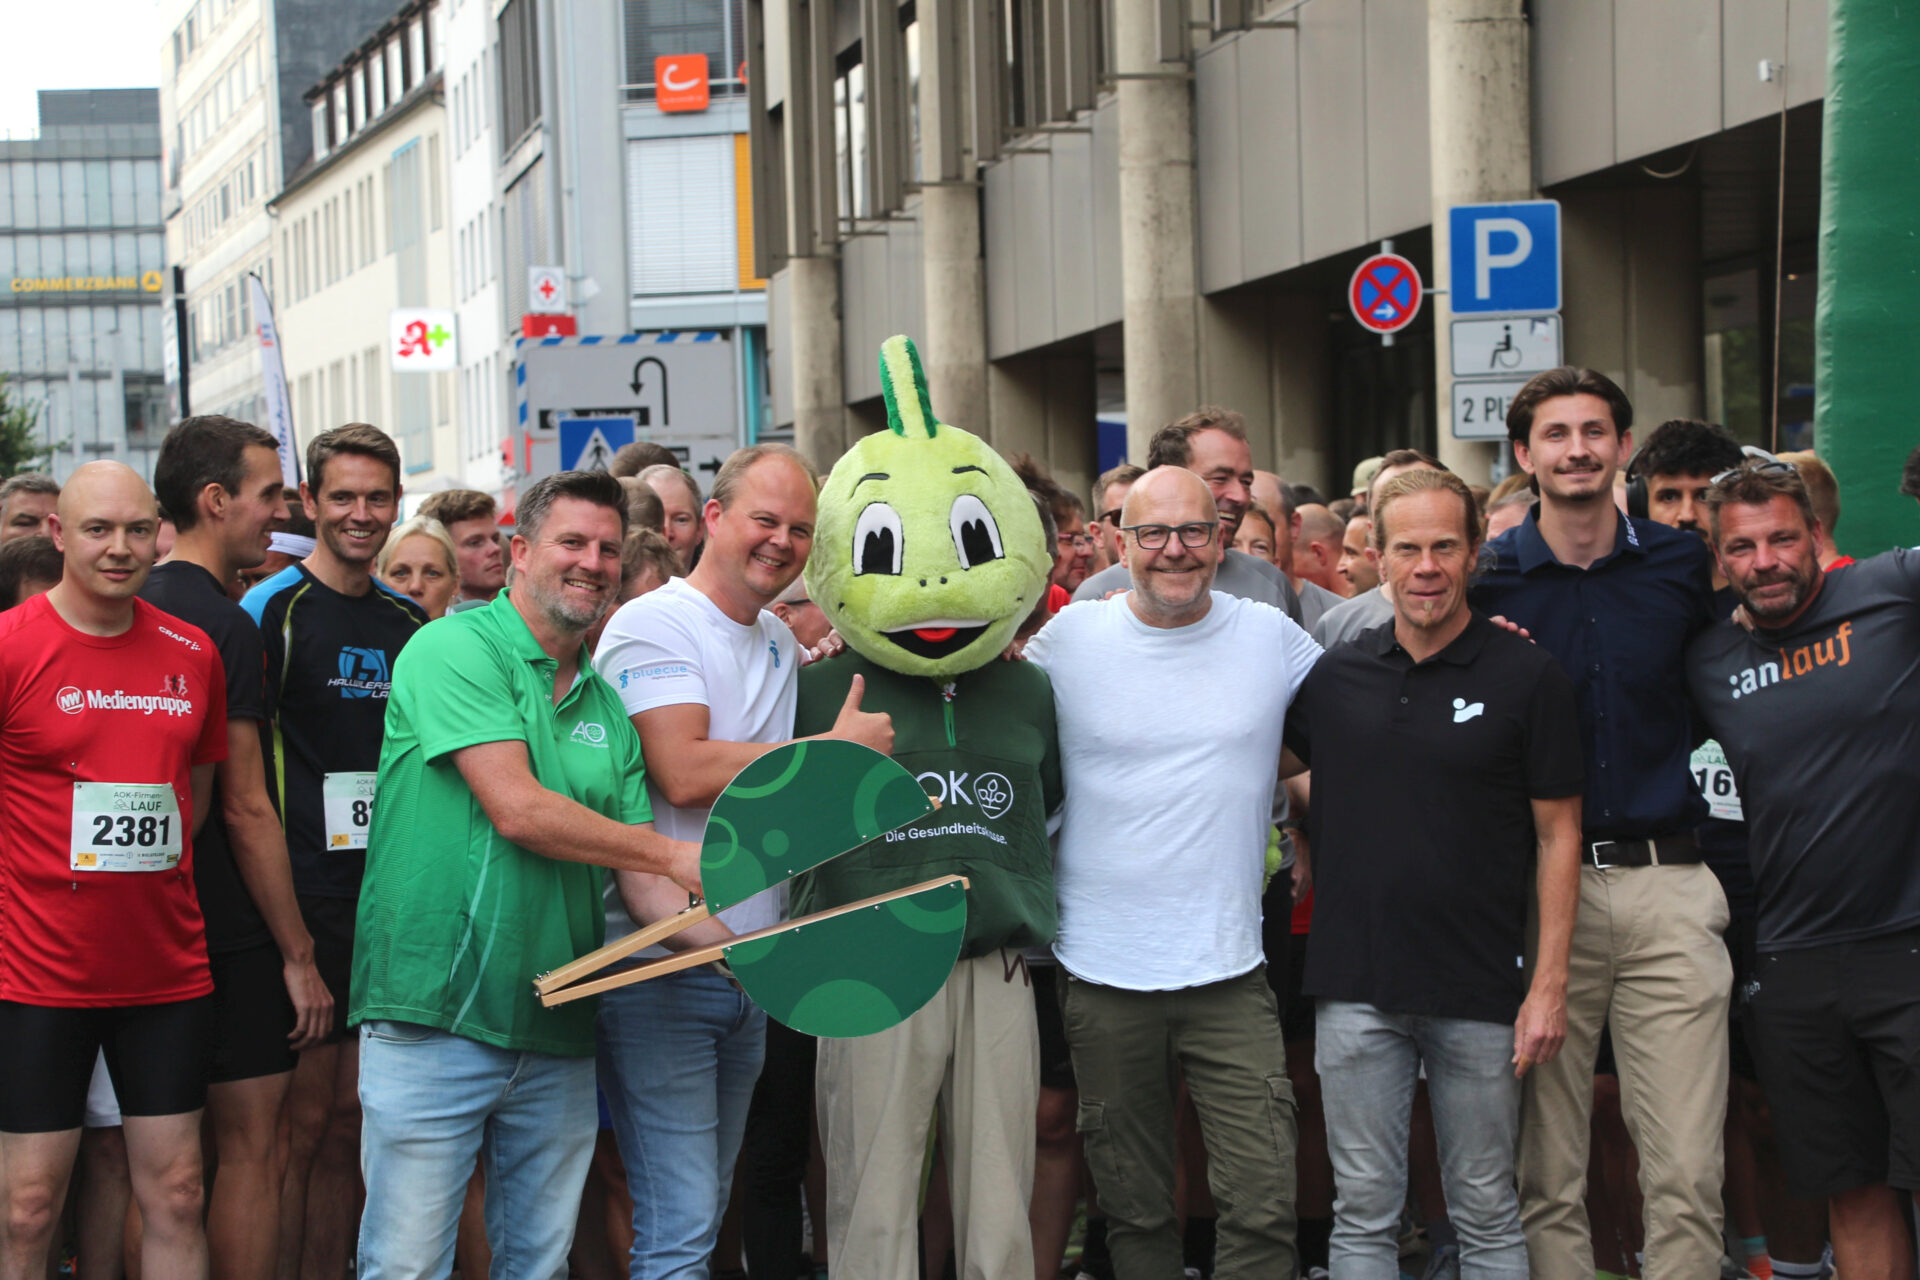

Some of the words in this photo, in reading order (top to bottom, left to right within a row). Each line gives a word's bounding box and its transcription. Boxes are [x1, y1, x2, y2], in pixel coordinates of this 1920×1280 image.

[1475, 217, 1533, 300] P
[11, 277, 137, 292] COMMERZBANK
[1462, 397, 1475, 423] 2
[158, 625, 193, 646] CRAFT
[632, 665, 687, 680] bluecue
[60, 691, 81, 710] NW
[87, 689, 192, 717] Mediengruppe
[1695, 767, 1740, 797] 16
[114, 791, 163, 799] AOK-Firmen-
[131, 800, 162, 811] LAUF
[352, 799, 374, 827] 8
[92, 815, 170, 847] 2381
[885, 829, 906, 843] Die
